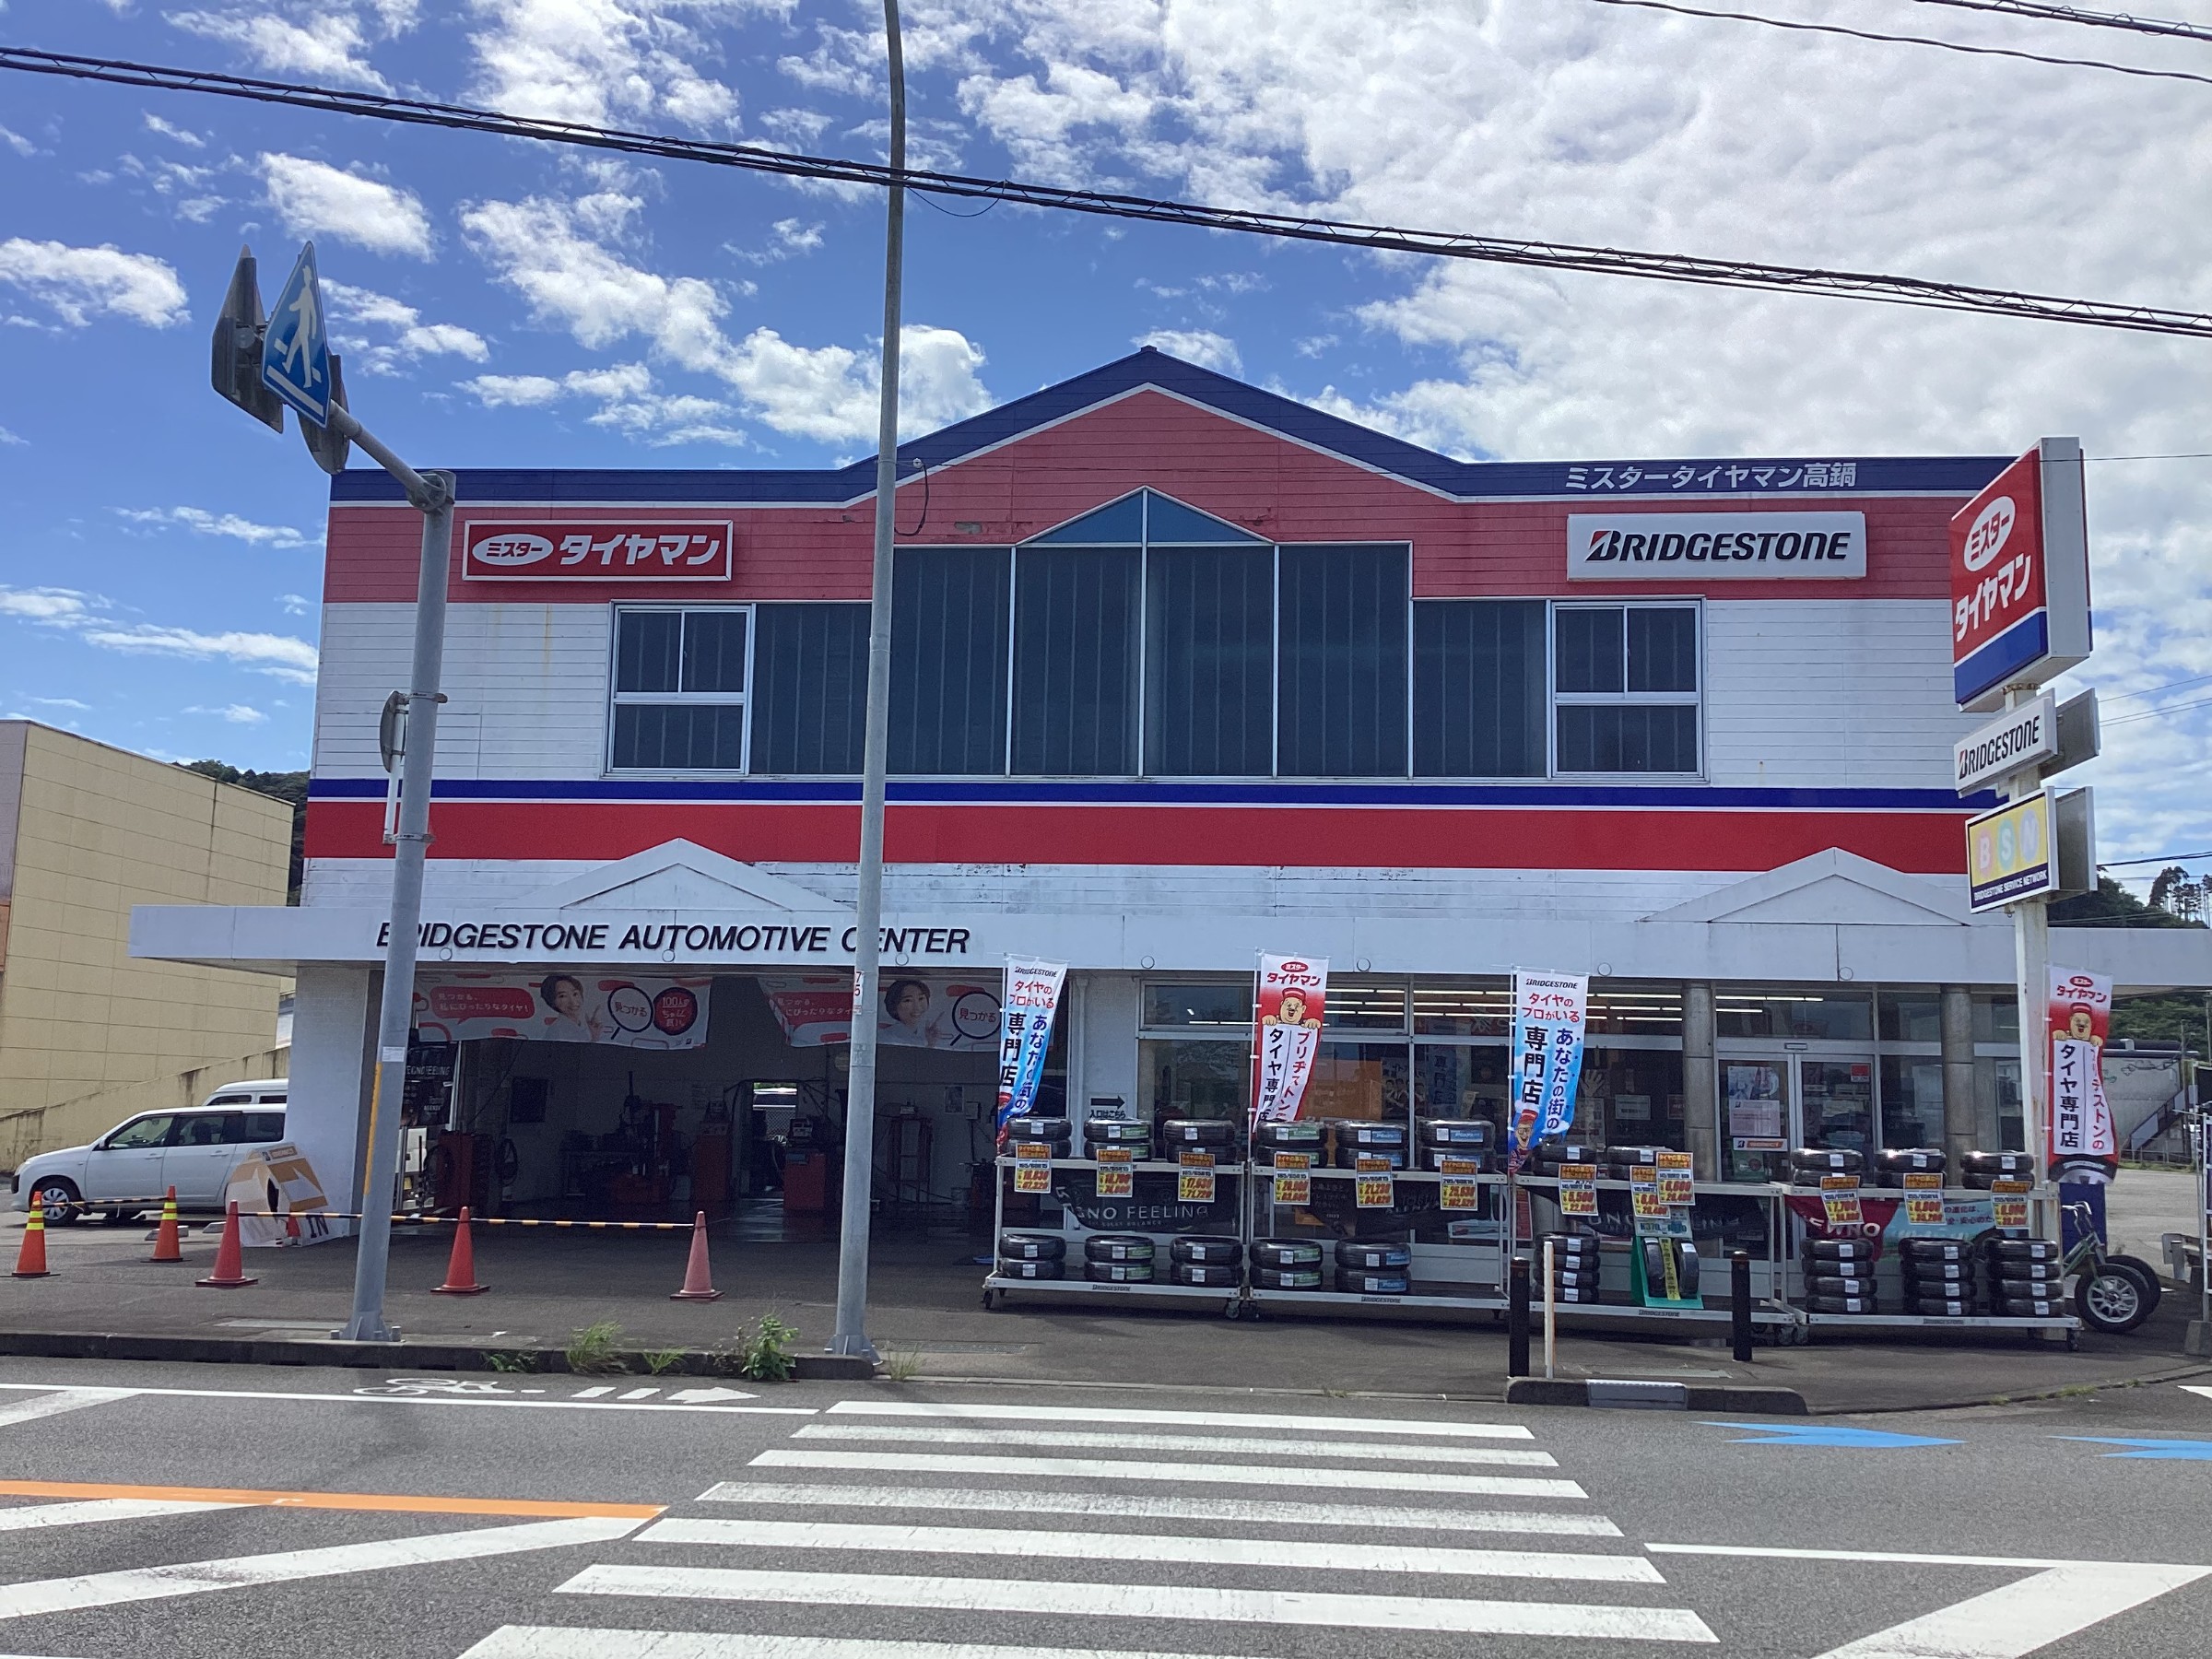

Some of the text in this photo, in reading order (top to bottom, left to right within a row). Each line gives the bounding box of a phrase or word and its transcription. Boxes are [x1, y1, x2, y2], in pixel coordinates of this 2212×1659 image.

[1565, 463, 1857, 489] ミスタータイヤマン高鍋
[487, 534, 720, 565] ミスター タイヤマン
[1584, 530, 1851, 561] BRIDGESTONE
[1971, 511, 2010, 562] ミスター
[1955, 553, 2031, 642] タイヤマン
[1959, 715, 2040, 780] BRIDGESTONE
[1974, 869, 2048, 901] BRIDGESTONE SERVICE NETWORK
[377, 923, 970, 954] BIDGESTONE AUTOMOTIVE CNTER
[1015, 966, 1057, 978] BRIDGESTONE
[1015, 980, 1053, 995] タイヤの
[1266, 972, 1321, 986] タイヤマン
[1525, 978, 1578, 990] BRIDGESTONE
[1528, 992, 1573, 1007] タイヤの
[2056, 984, 2107, 1003] タイヤマン
[959, 1007, 996, 1023] 見つかる
[1521, 1006, 1581, 1023] プロがいる
[1000, 1012, 1028, 1088] 専門店
[1522, 1026, 1549, 1105] 専門店
[1547, 1028, 1574, 1131] あなたの街の
[2060, 1043, 2079, 1148] タイヤ専門店
[1089, 1109, 1126, 1119] 入口はこちら
